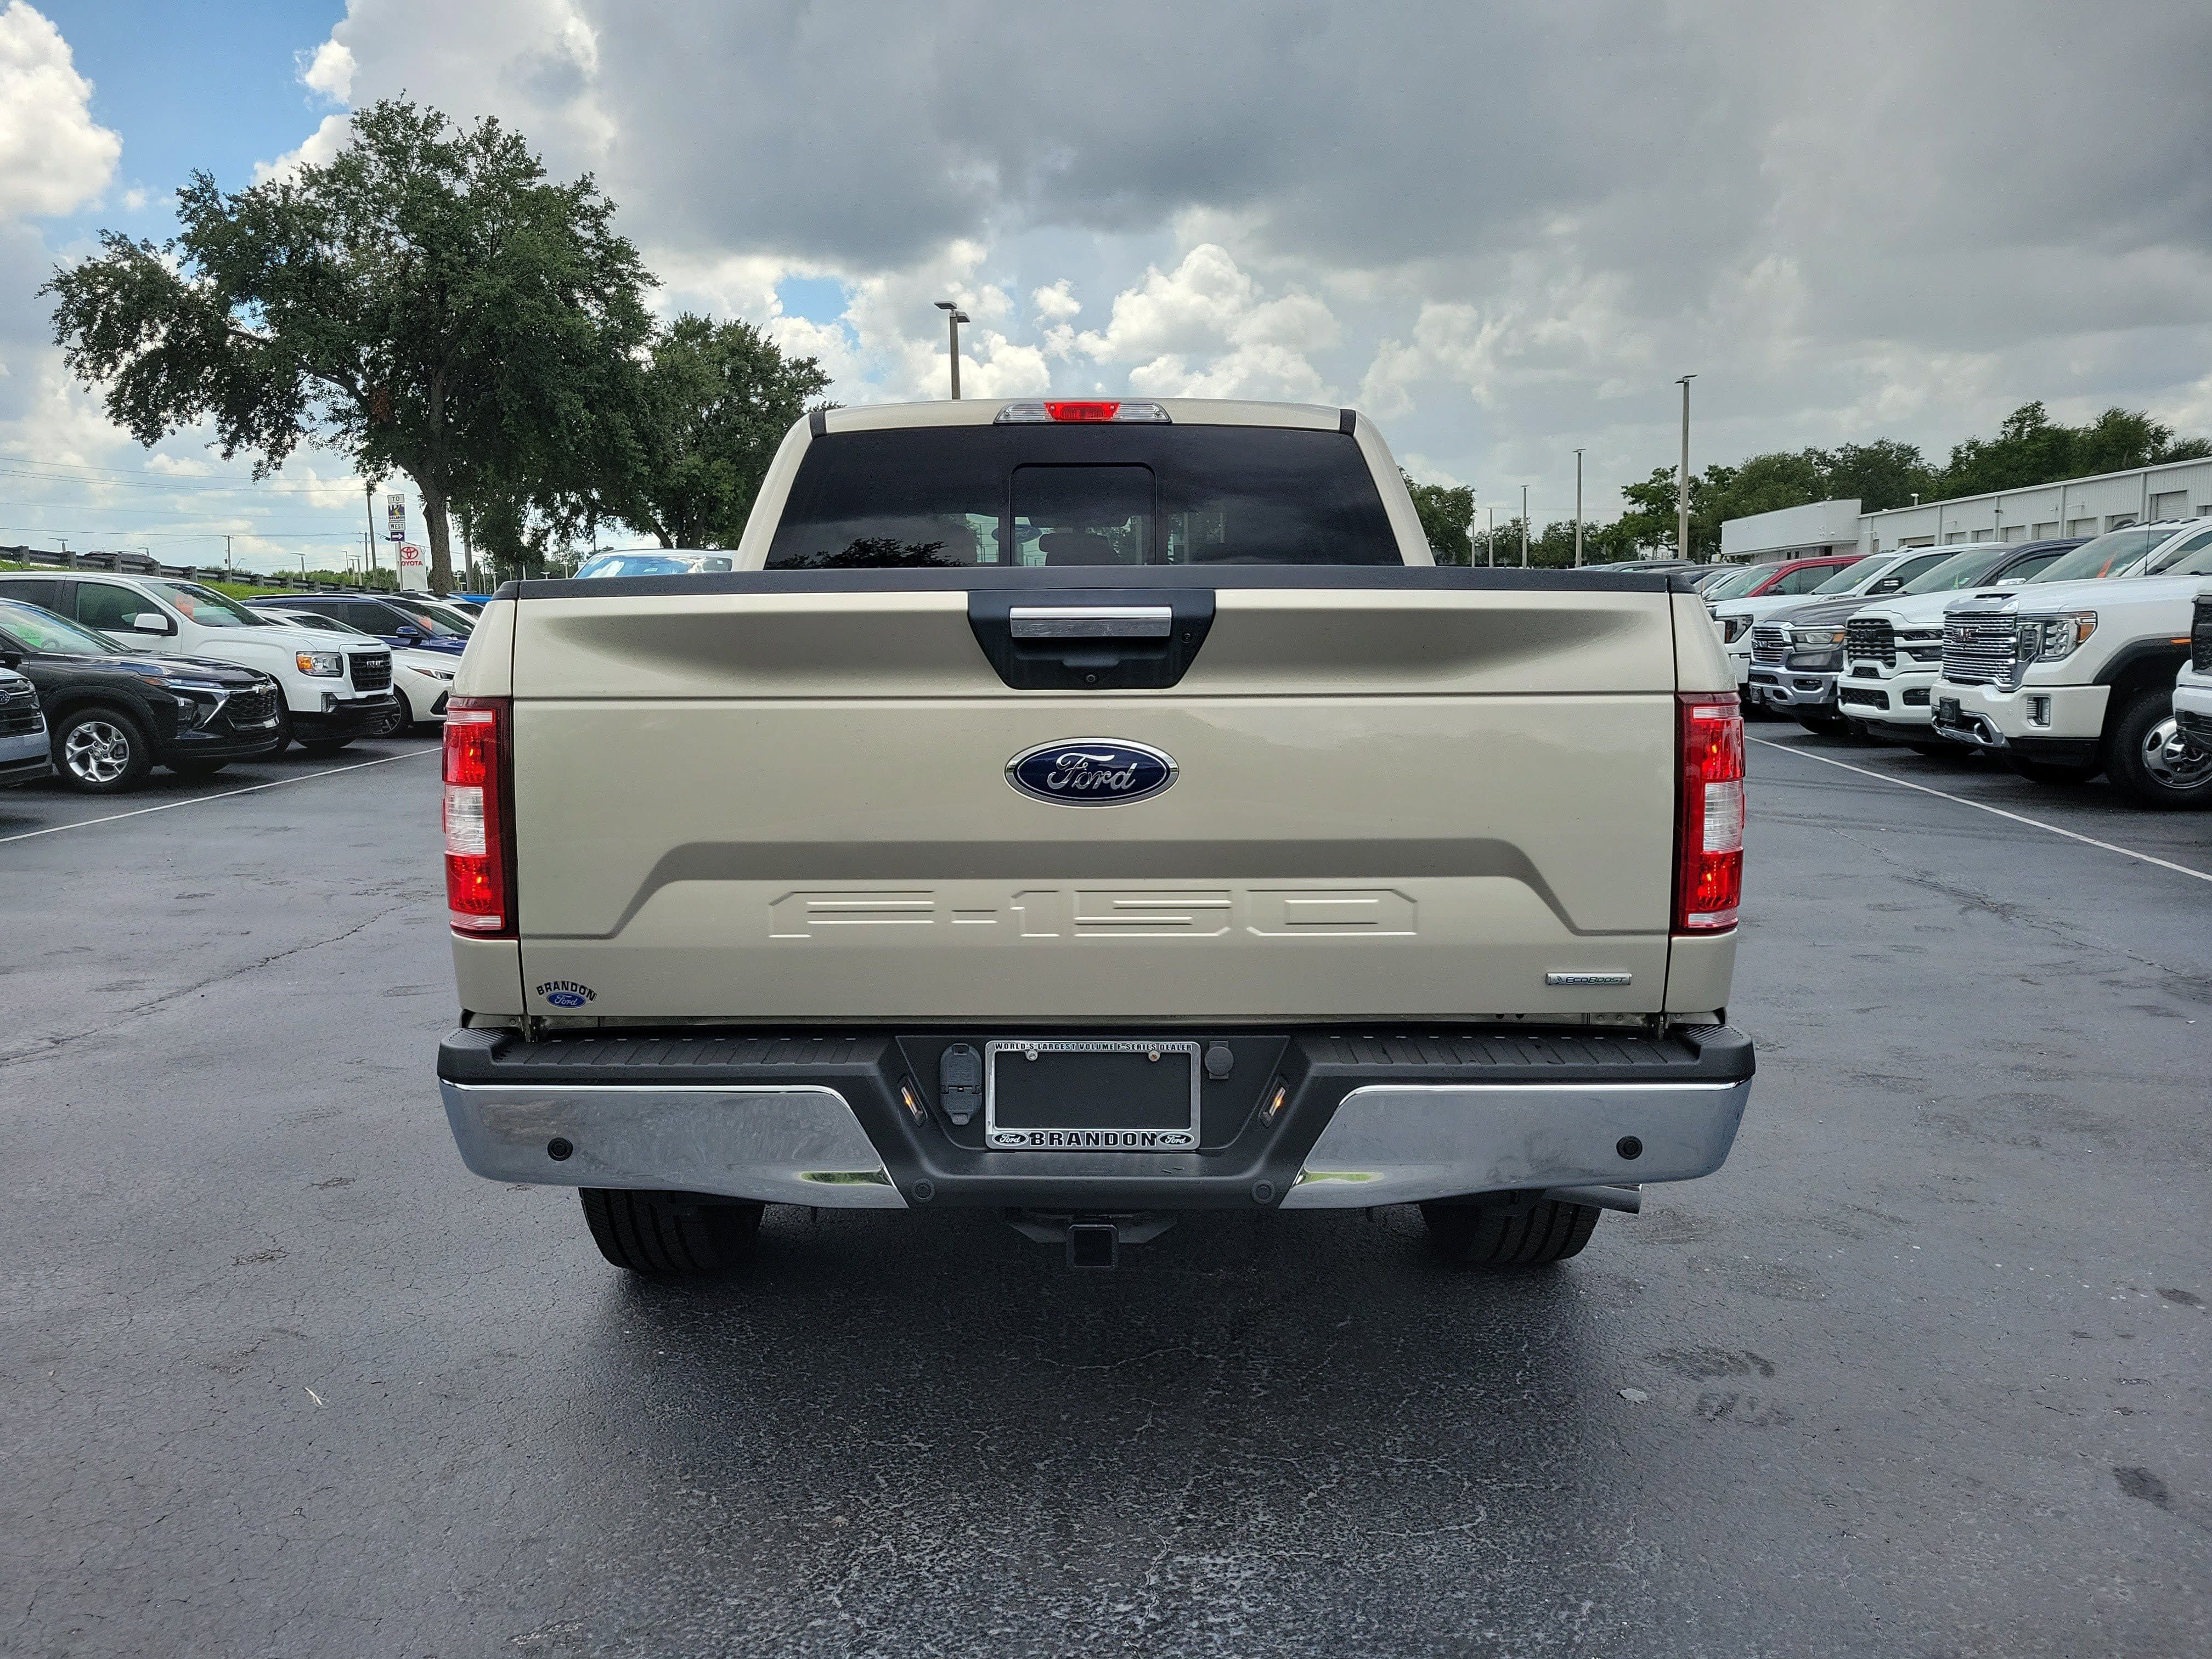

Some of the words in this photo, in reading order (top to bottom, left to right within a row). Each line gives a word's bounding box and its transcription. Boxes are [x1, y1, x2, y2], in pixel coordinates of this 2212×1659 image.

[1047, 753, 1138, 790] Ford
[769, 889, 1417, 937] F-150
[536, 981, 597, 1002] BRANDON
[554, 994, 578, 1006] Ford
[999, 1133, 1020, 1143] Ford
[1030, 1131, 1157, 1147] BRANDON
[1165, 1134, 1187, 1144] Ford
